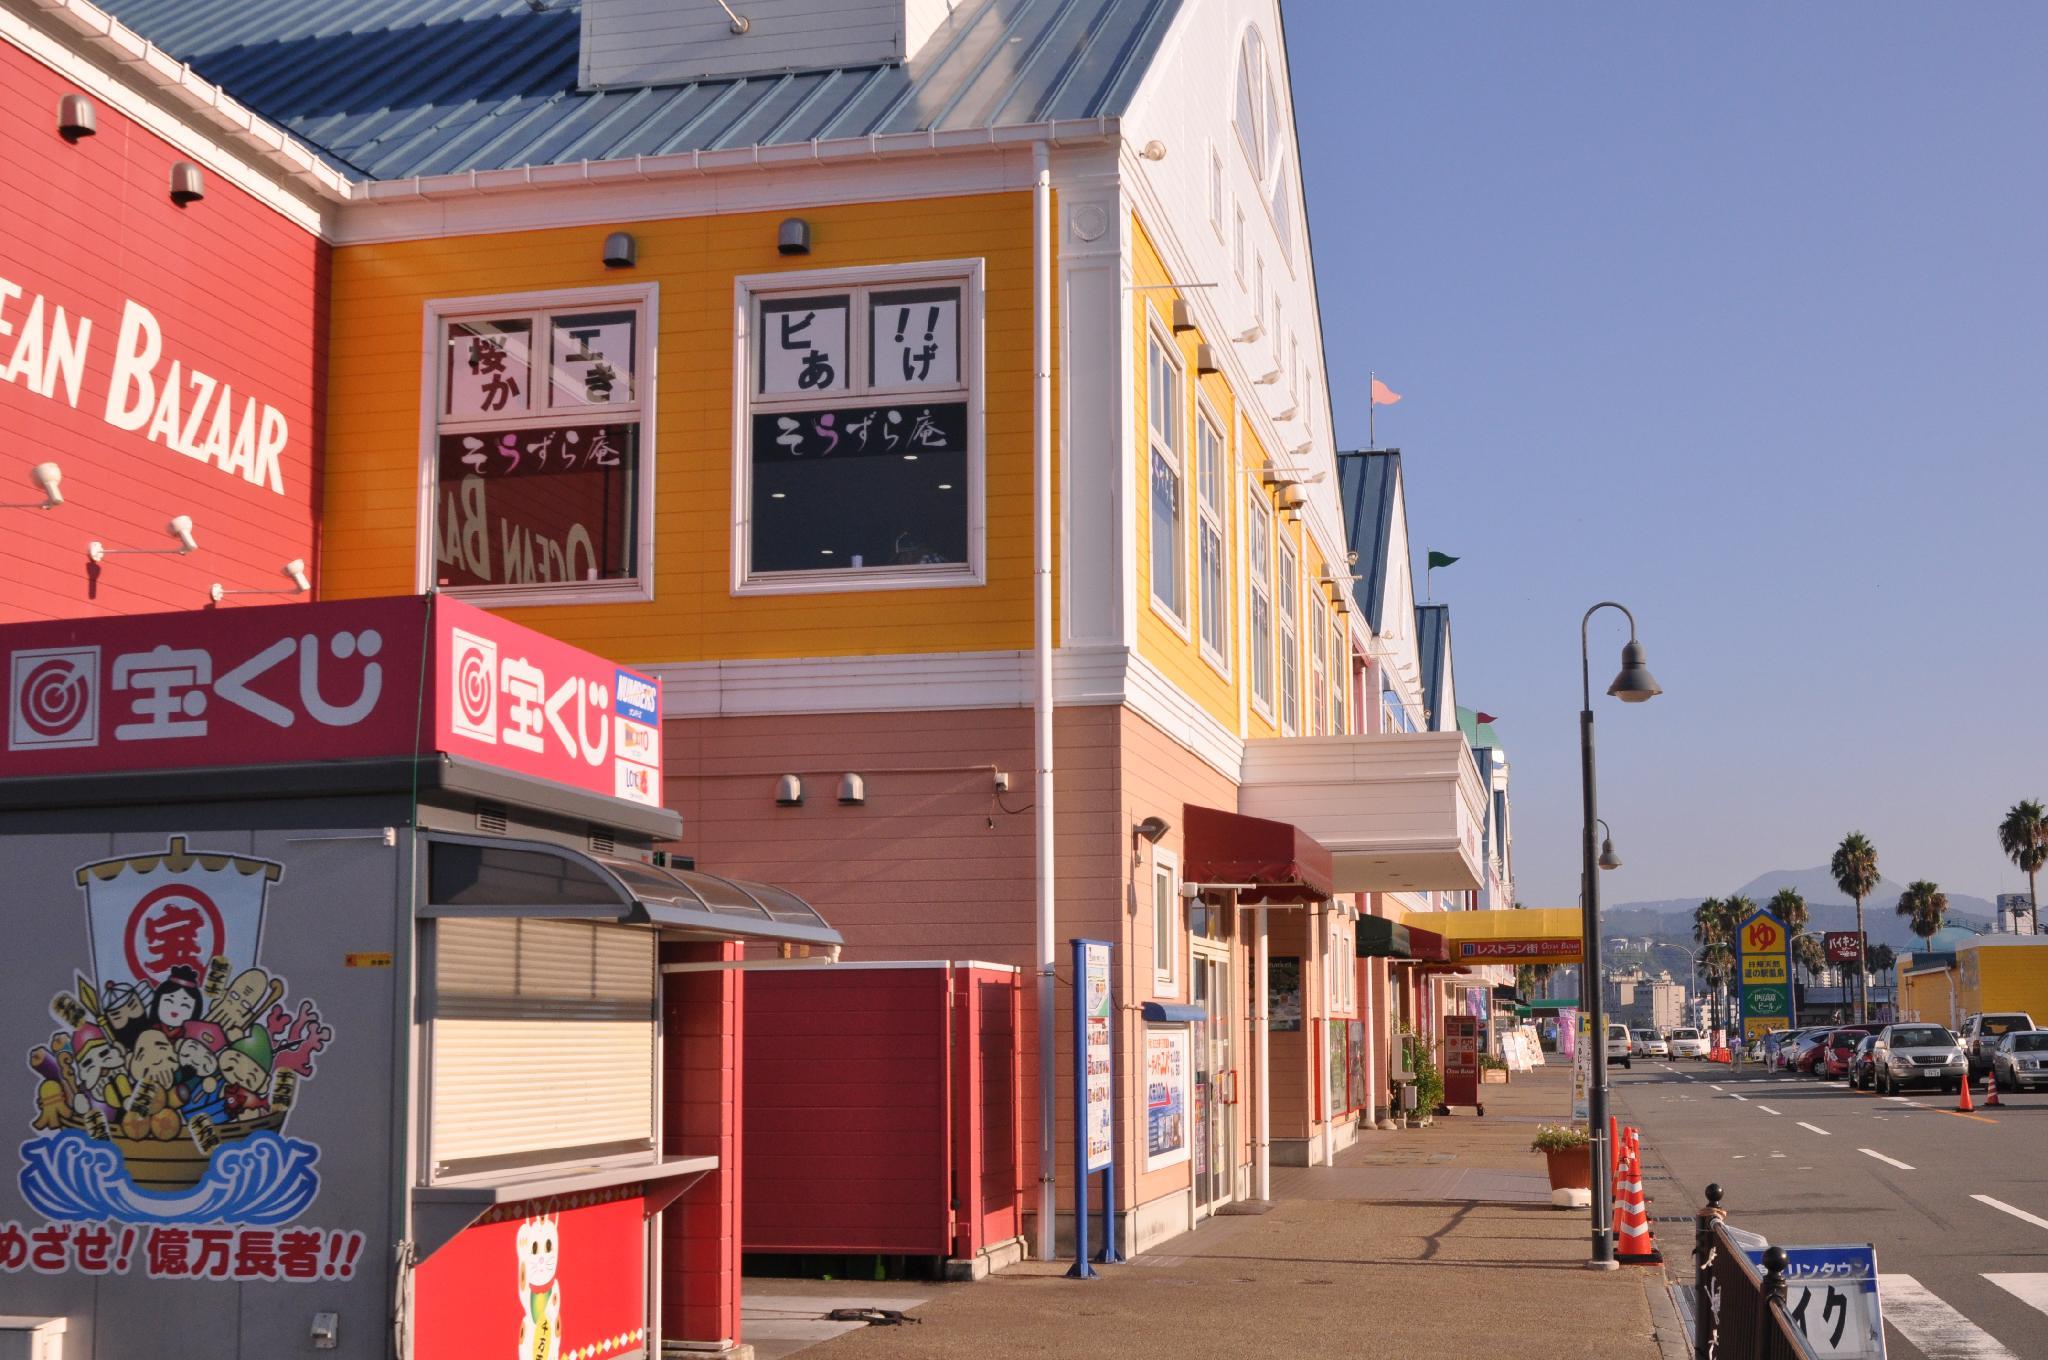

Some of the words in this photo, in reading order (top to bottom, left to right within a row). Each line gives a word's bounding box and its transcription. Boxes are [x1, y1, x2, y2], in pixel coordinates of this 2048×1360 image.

[104, 299, 289, 495] BAZAAR
[112, 629, 382, 740] 宝くじ
[500, 657, 608, 766] 宝くじ
[145, 904, 205, 972] 宝
[1477, 943, 1538, 954] レストラン街
[1749, 922, 1777, 951] ゆ
[148, 1227, 363, 1278] 億万長者!!
